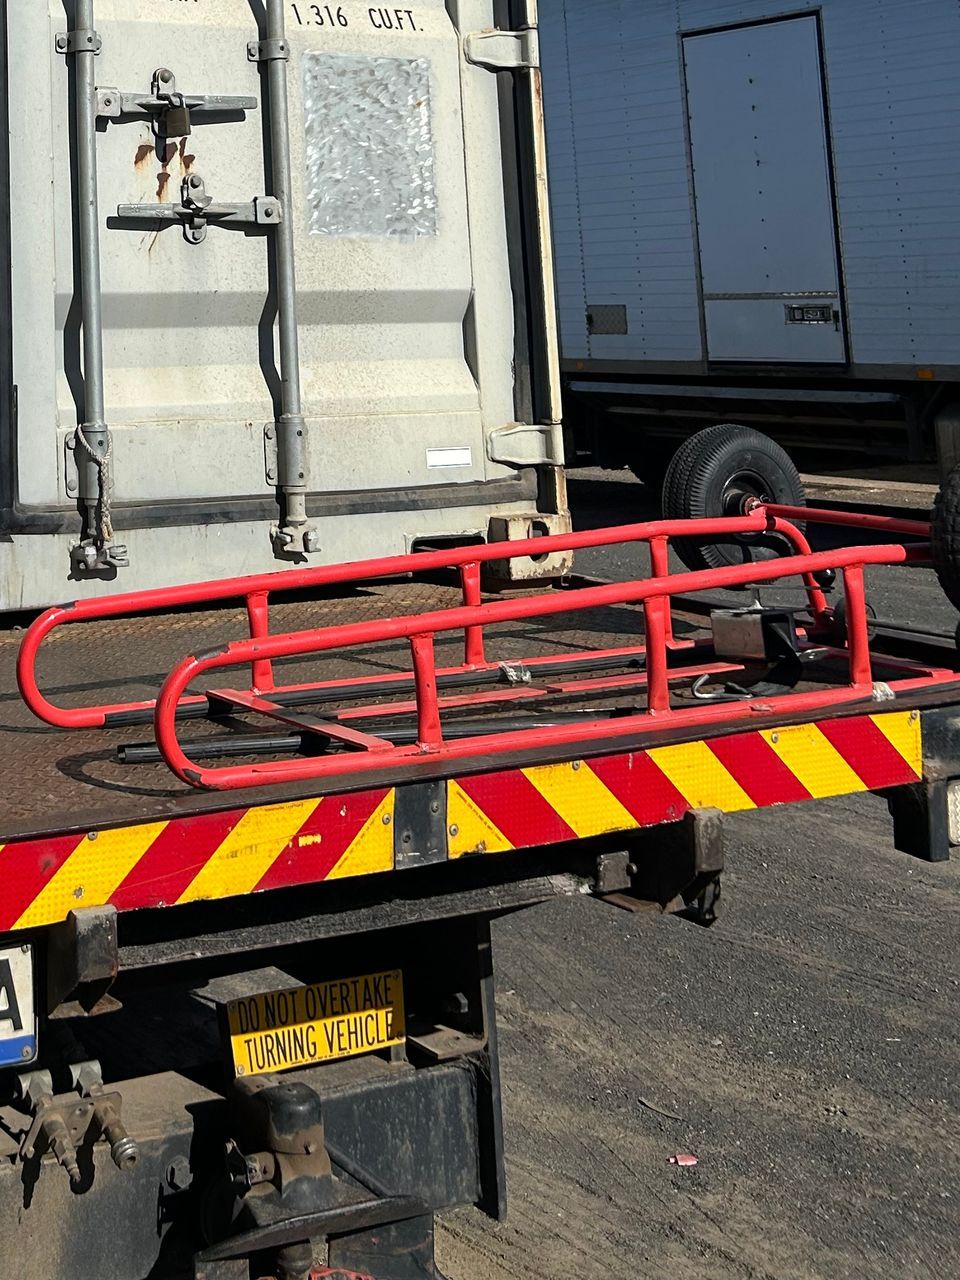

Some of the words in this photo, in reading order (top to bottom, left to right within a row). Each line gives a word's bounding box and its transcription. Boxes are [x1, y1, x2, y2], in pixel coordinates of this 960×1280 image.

[238, 997, 260, 1034] DO
[264, 990, 298, 1028] NOT
[304, 974, 394, 1020] OVERTAKE
[244, 1024, 317, 1073] TURNING
[323, 1009, 397, 1054] VEHICLE
